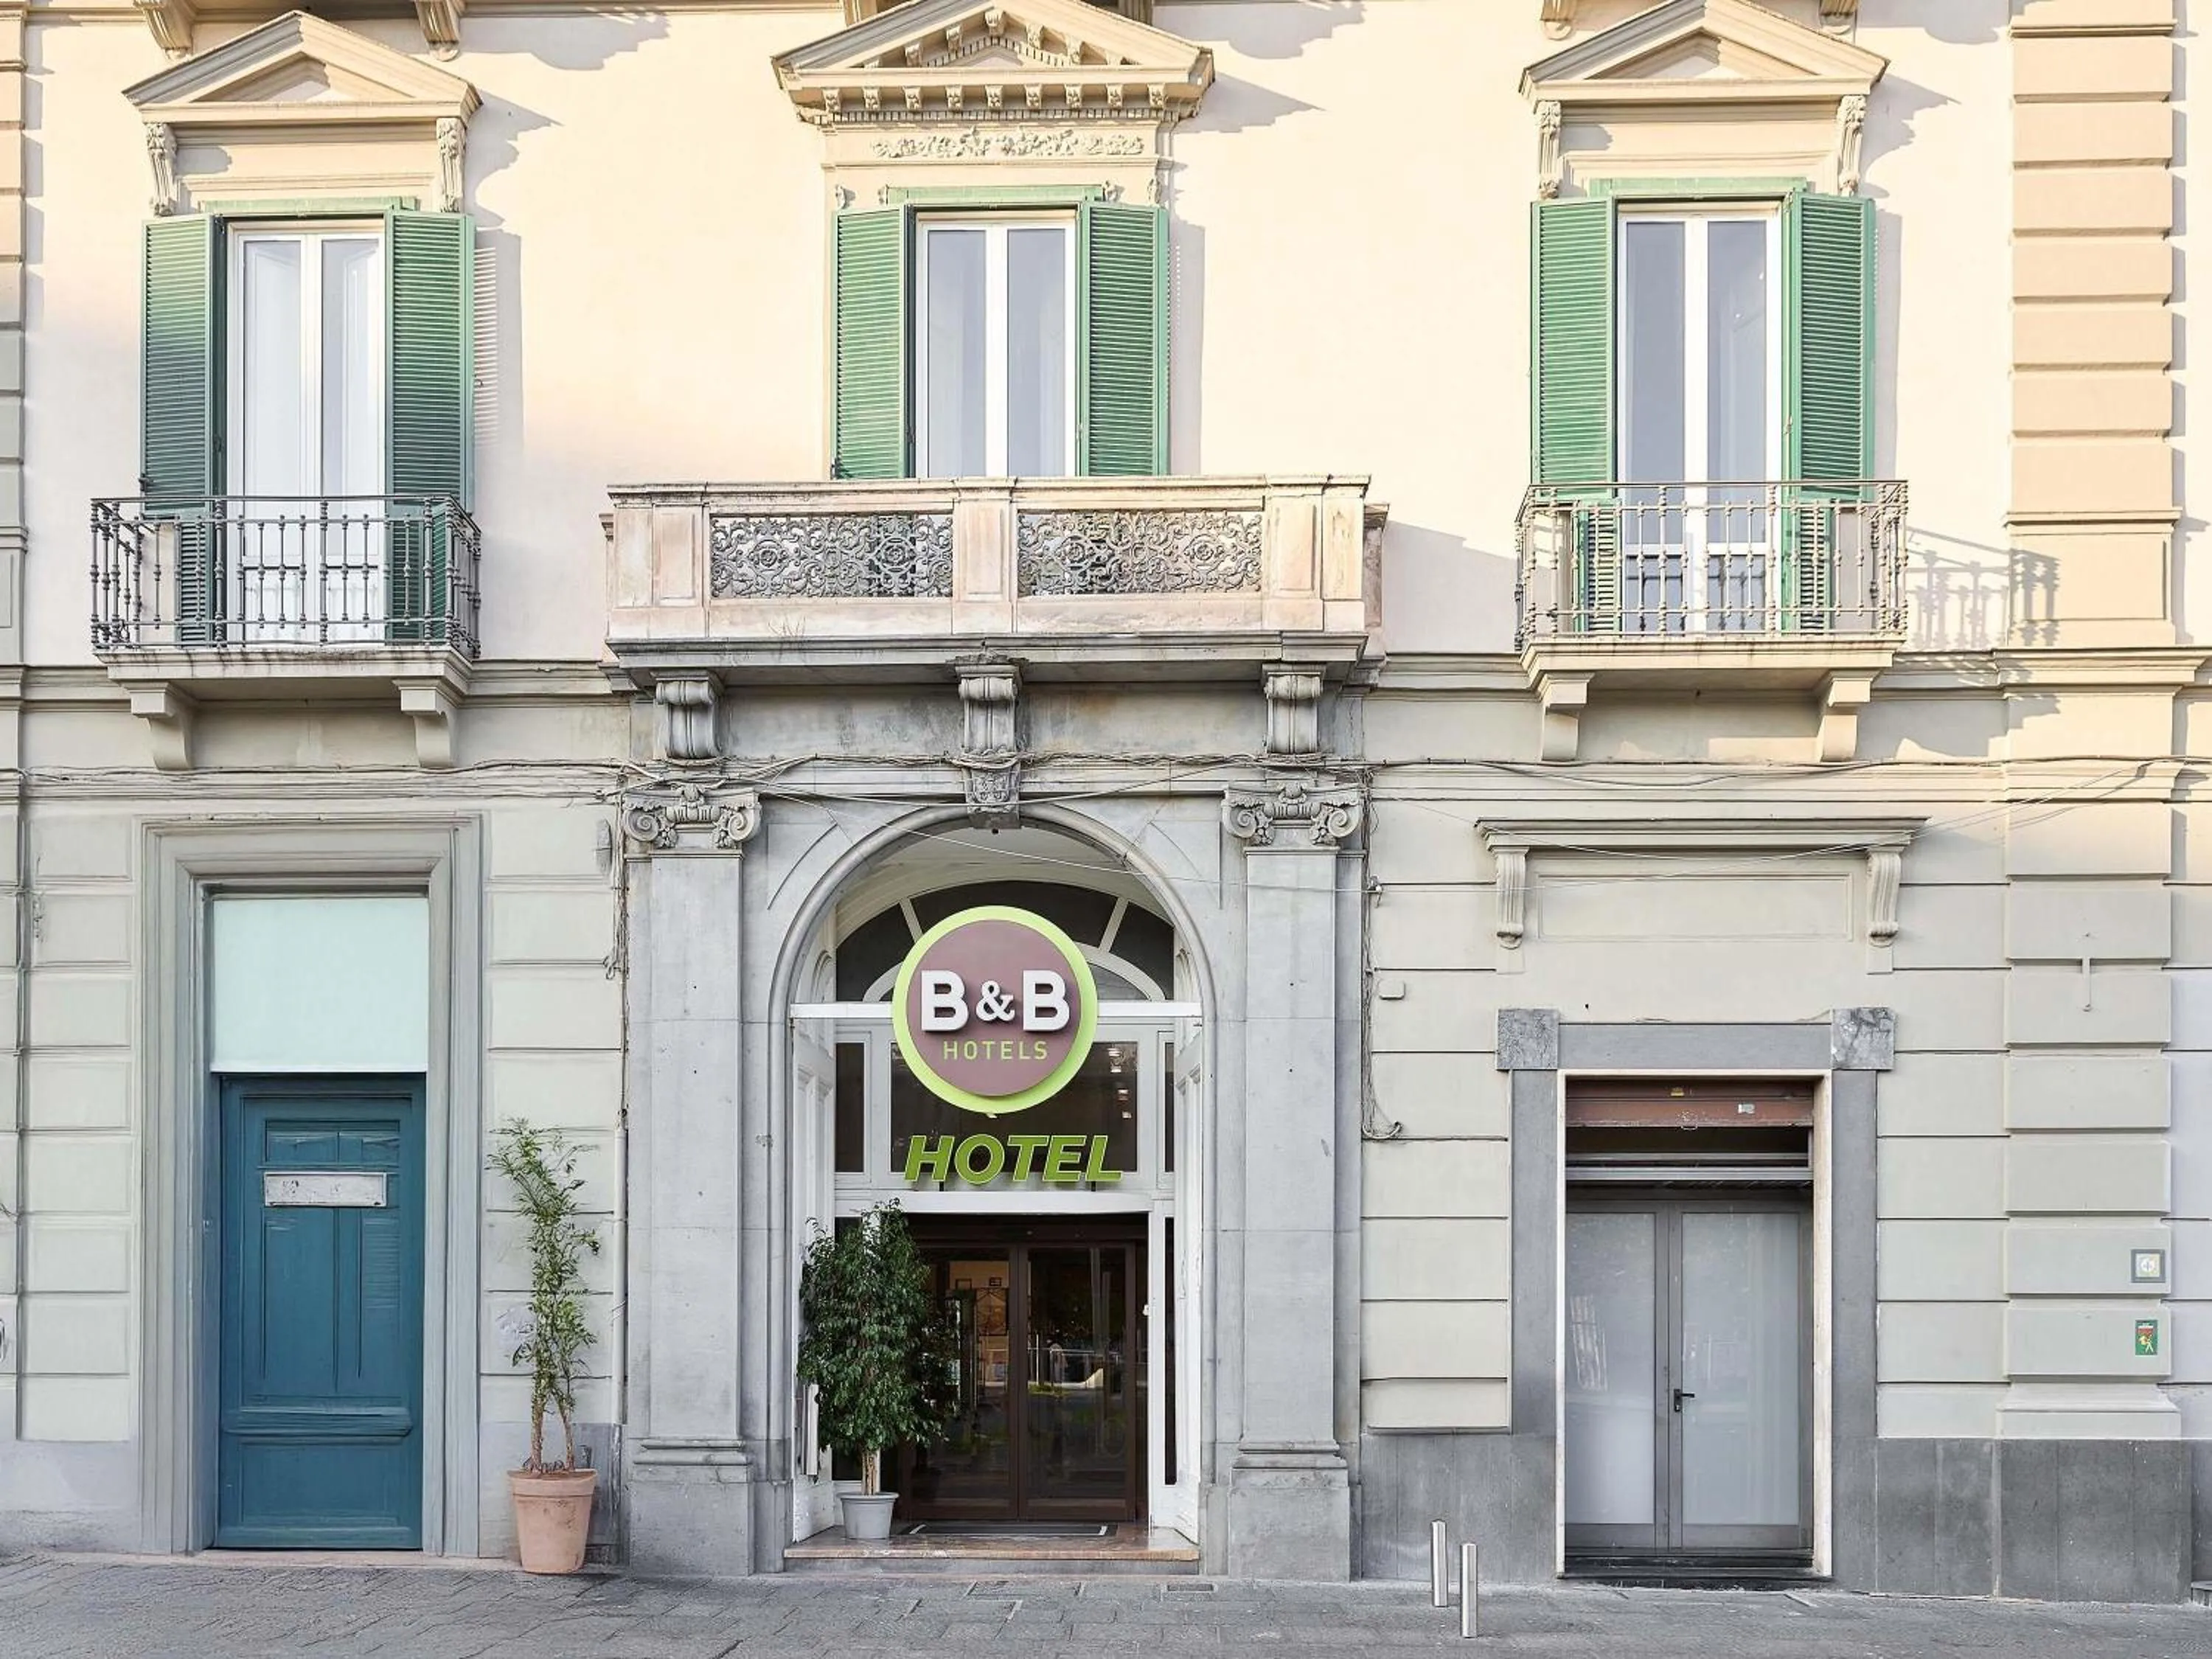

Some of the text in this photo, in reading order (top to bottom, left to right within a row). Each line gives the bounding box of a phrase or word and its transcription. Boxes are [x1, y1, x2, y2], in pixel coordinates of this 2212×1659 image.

[921, 970, 1071, 1032] B&B
[942, 1040, 1048, 1060] HOTELS
[904, 1133, 1123, 1185] HOTEL
